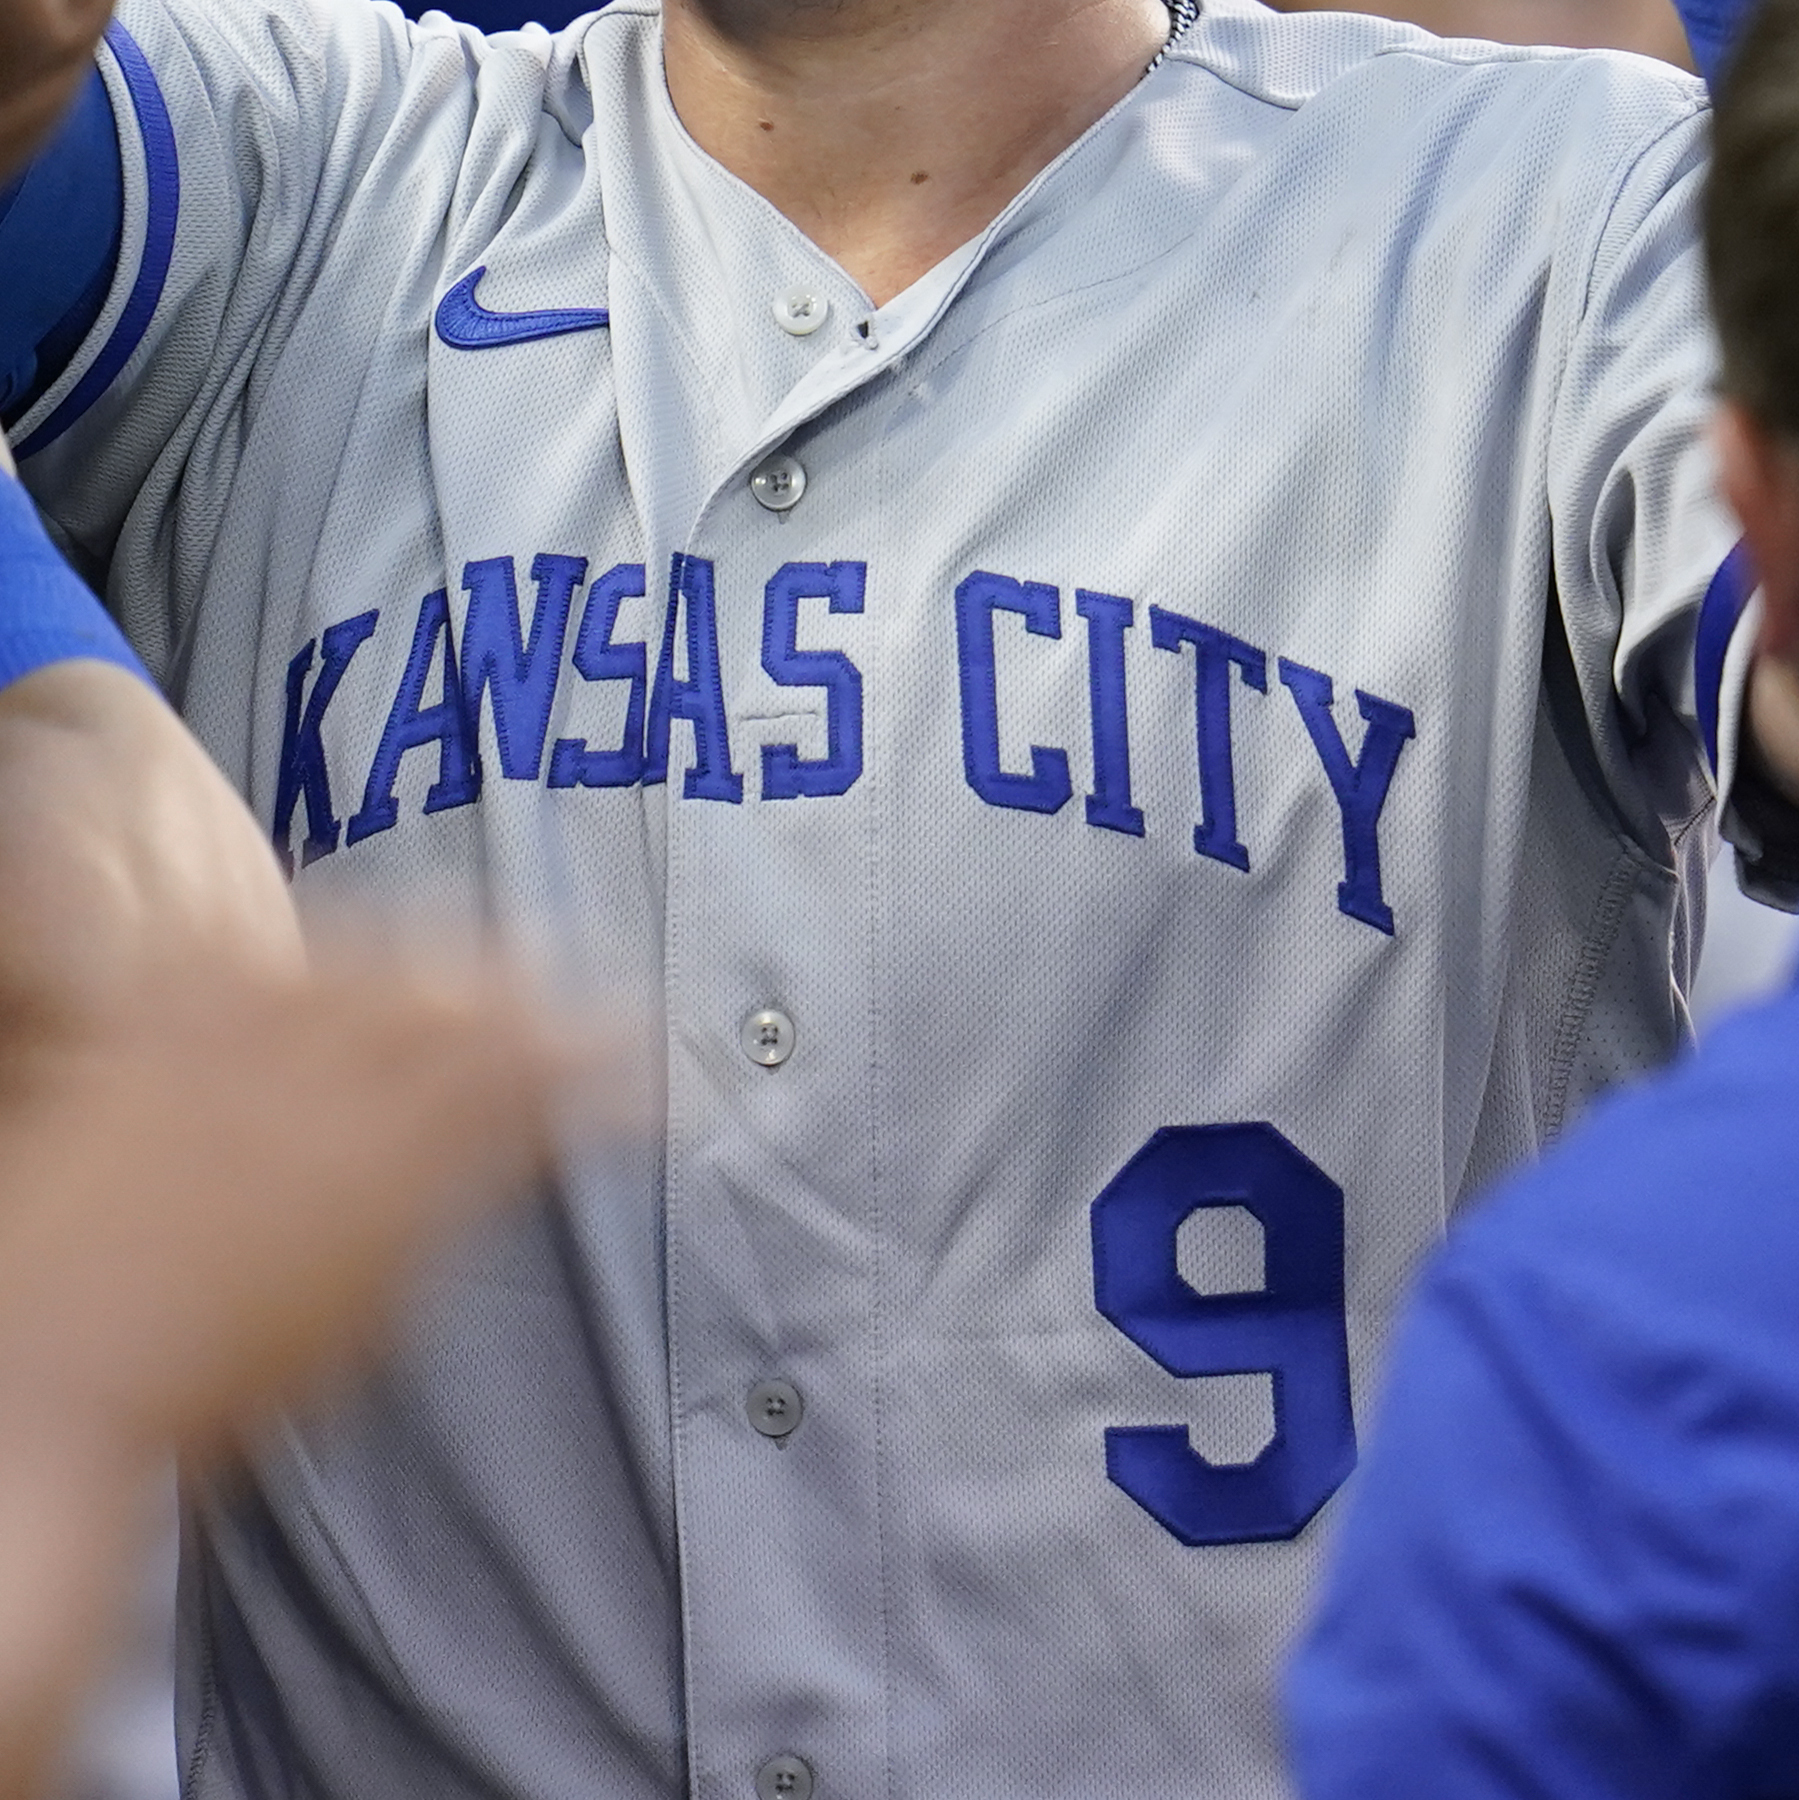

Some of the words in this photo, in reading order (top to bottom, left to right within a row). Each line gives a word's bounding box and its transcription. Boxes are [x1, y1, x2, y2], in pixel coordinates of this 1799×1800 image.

[272, 552, 867, 882] KANSAS
[954, 568, 1417, 936] CITY
[1090, 1120, 1358, 1548] 9
